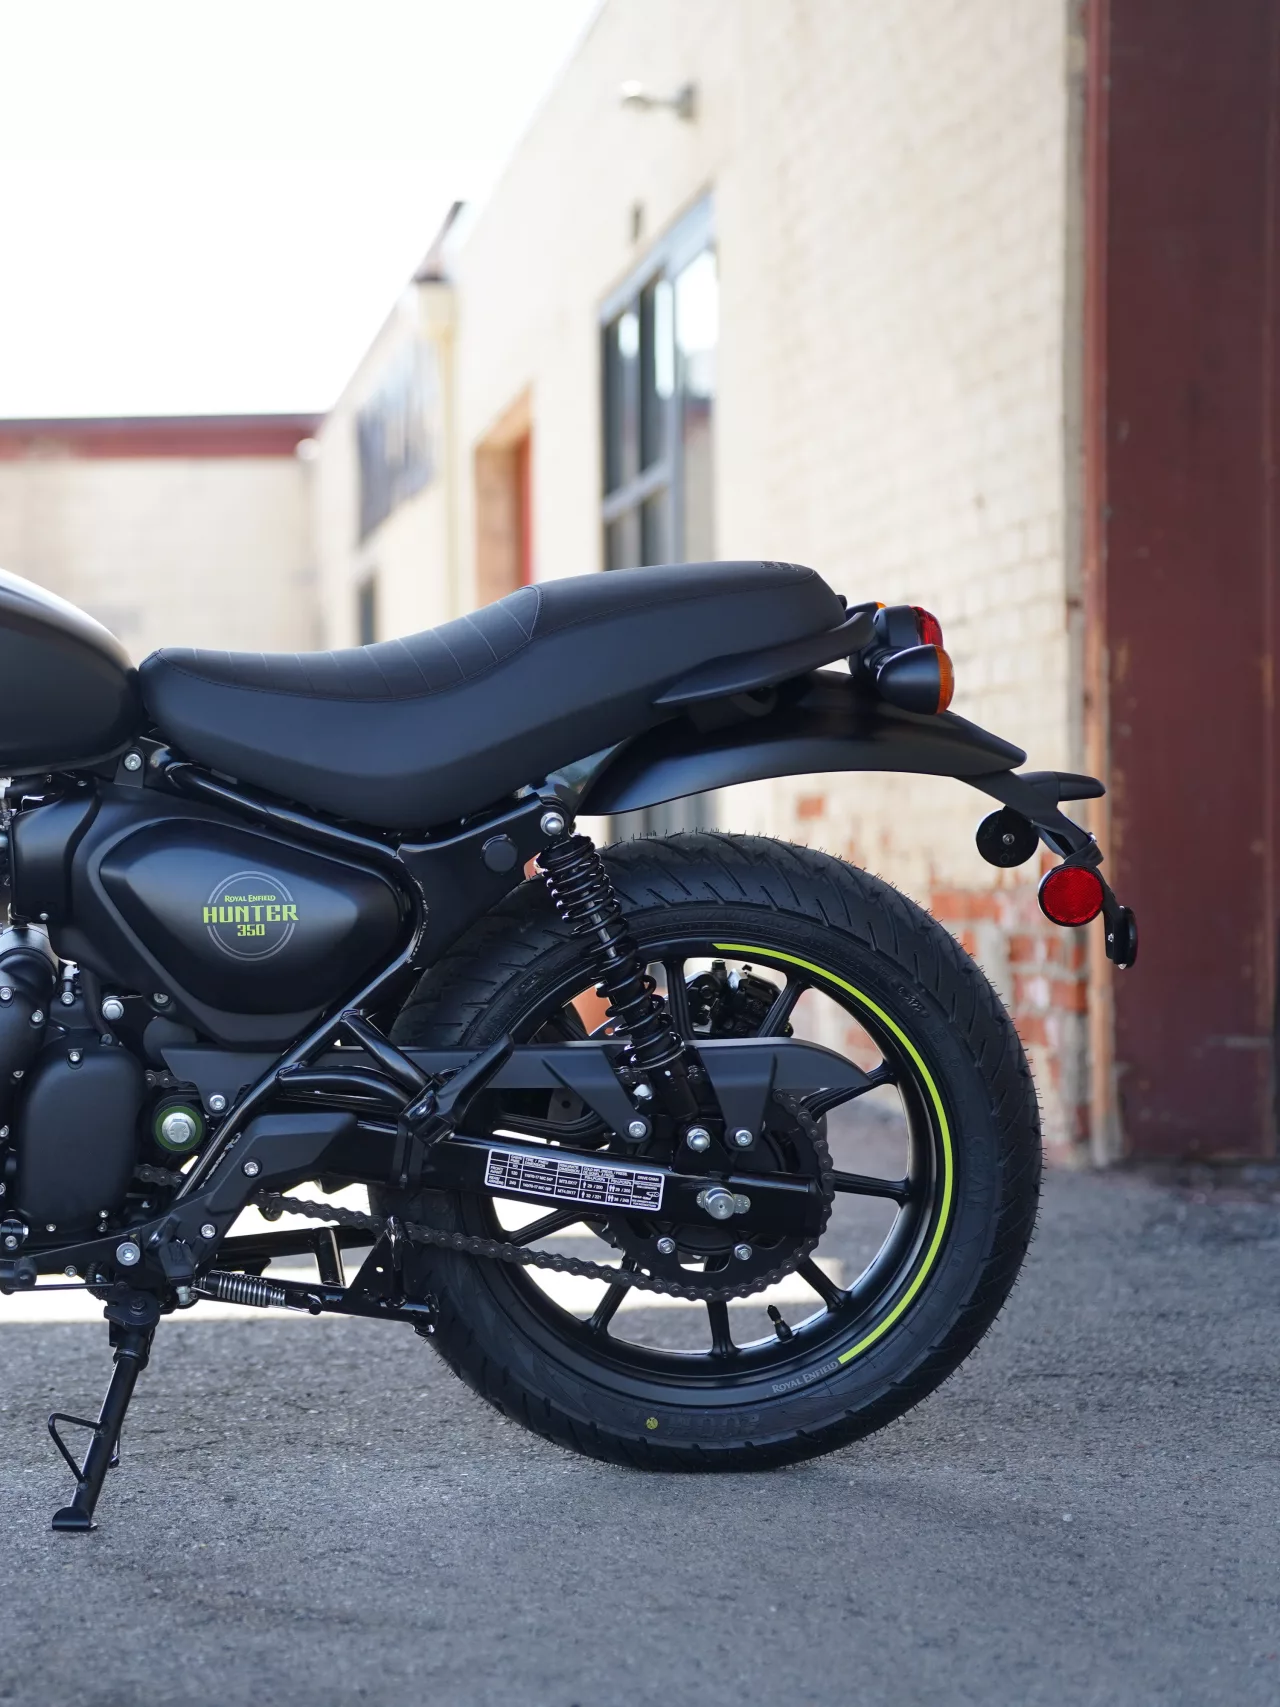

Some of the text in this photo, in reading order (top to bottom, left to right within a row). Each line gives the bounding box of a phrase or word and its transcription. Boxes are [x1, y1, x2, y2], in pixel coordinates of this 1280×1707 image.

[224, 894, 276, 903] ROYAL ENFIELD
[203, 904, 299, 923] HUNTER
[237, 924, 265, 937] 350
[772, 1361, 839, 1394] ROYAL ENFIELD
